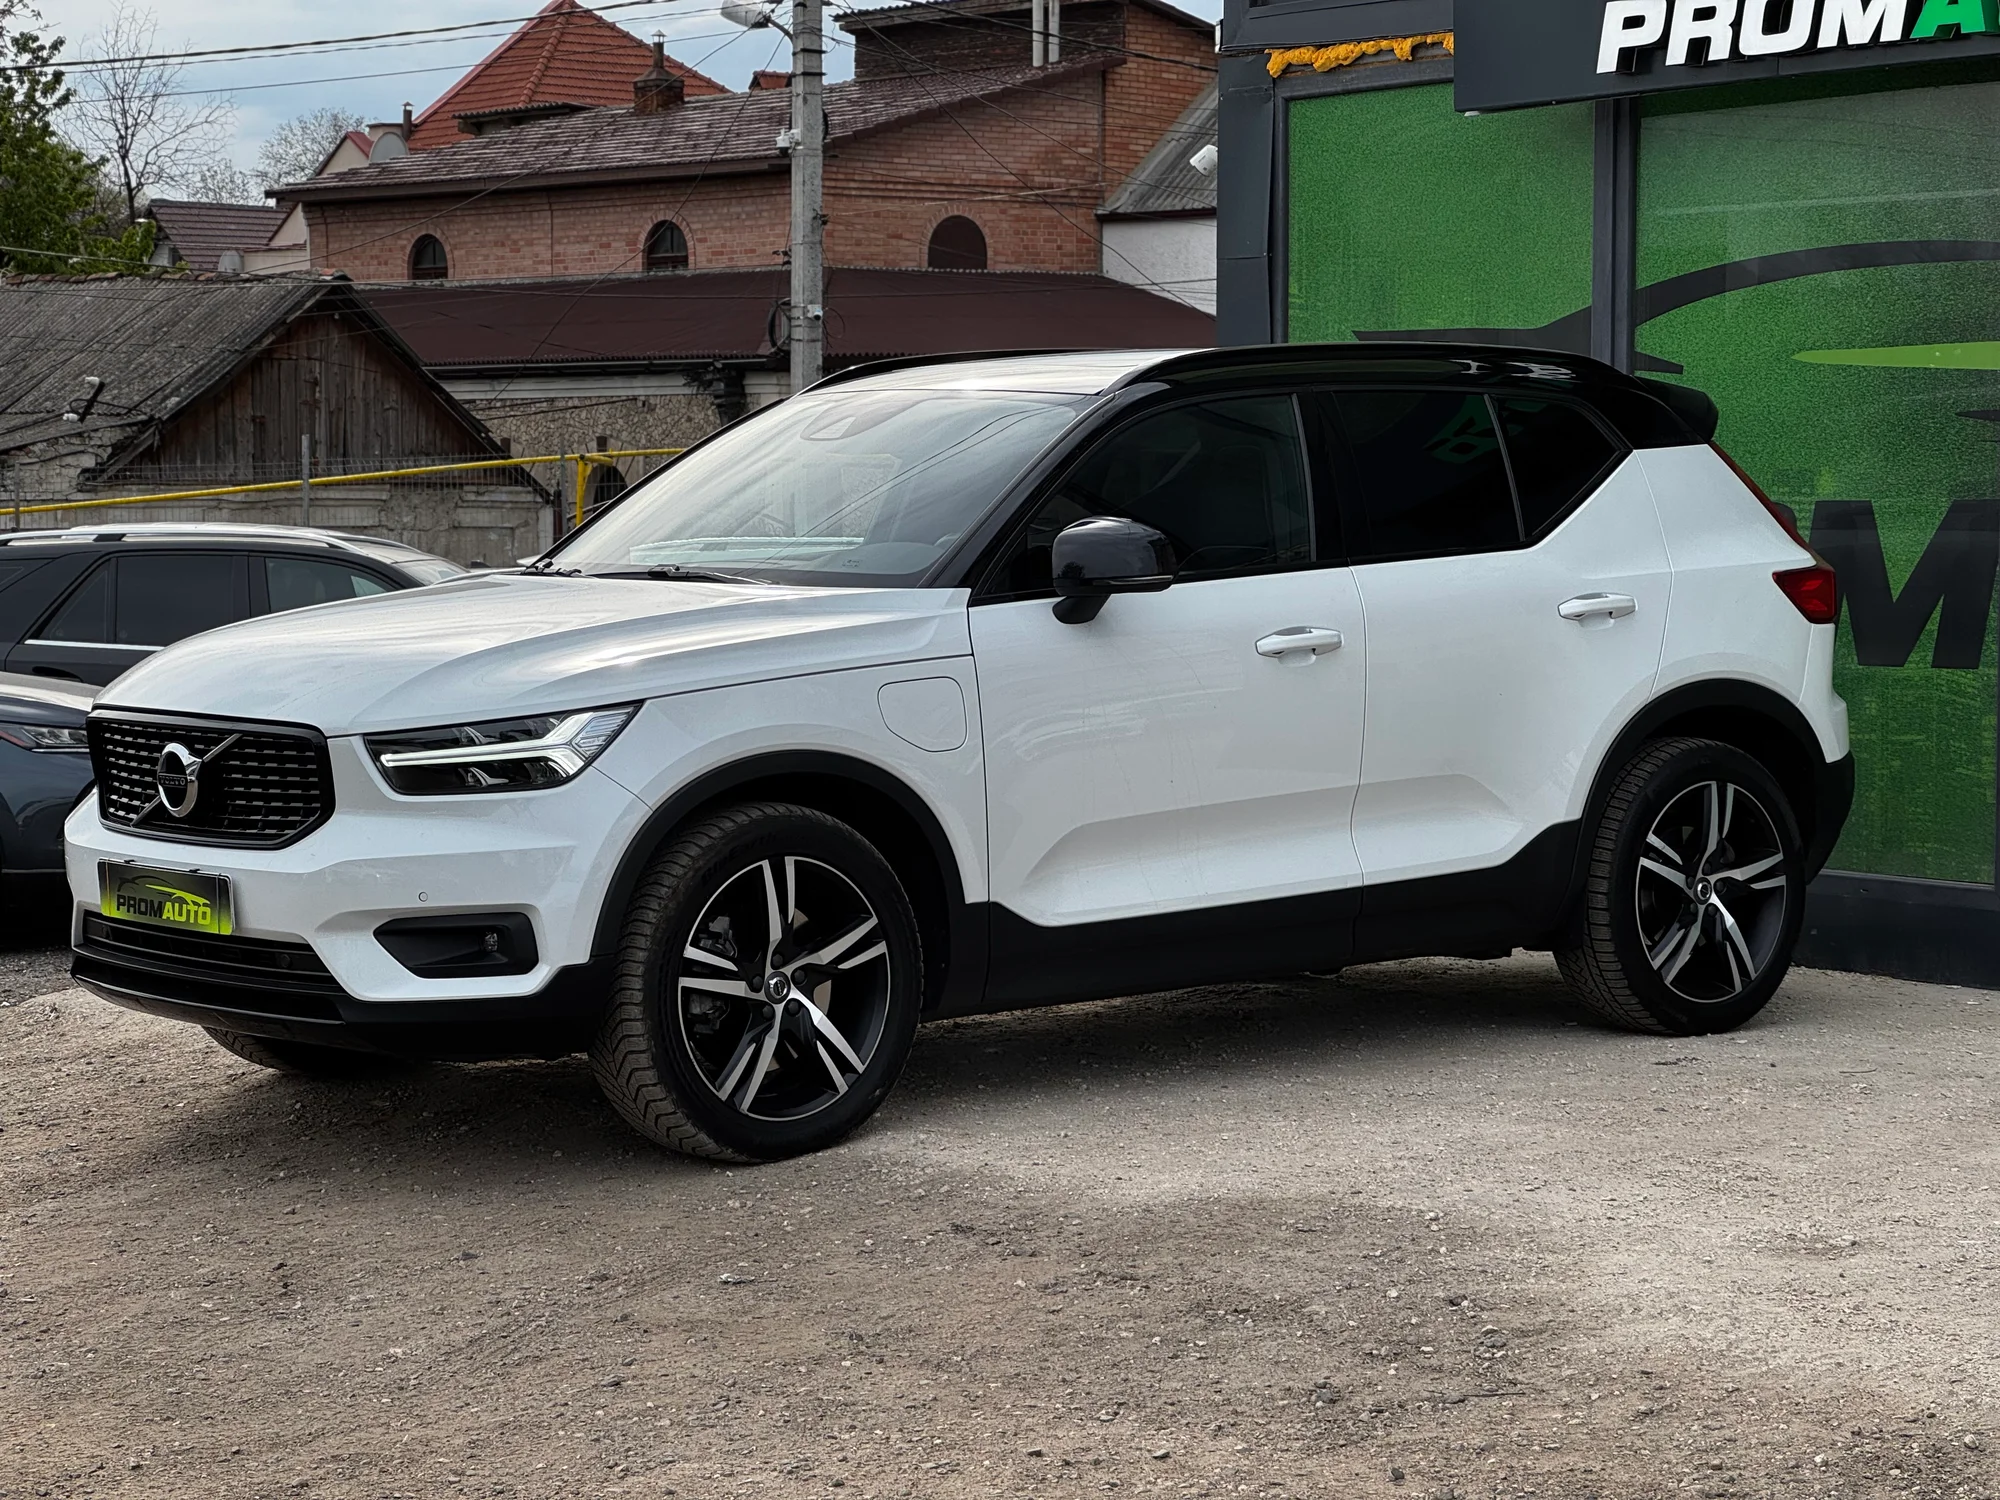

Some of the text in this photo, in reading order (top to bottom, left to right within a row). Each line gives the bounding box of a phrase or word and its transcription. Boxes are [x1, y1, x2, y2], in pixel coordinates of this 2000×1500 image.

[1596, 0, 2000, 74] PROMA
[1772, 499, 1999, 669] M
[159, 775, 186, 786] VOLVO
[116, 893, 211, 925] PROMAUTO
